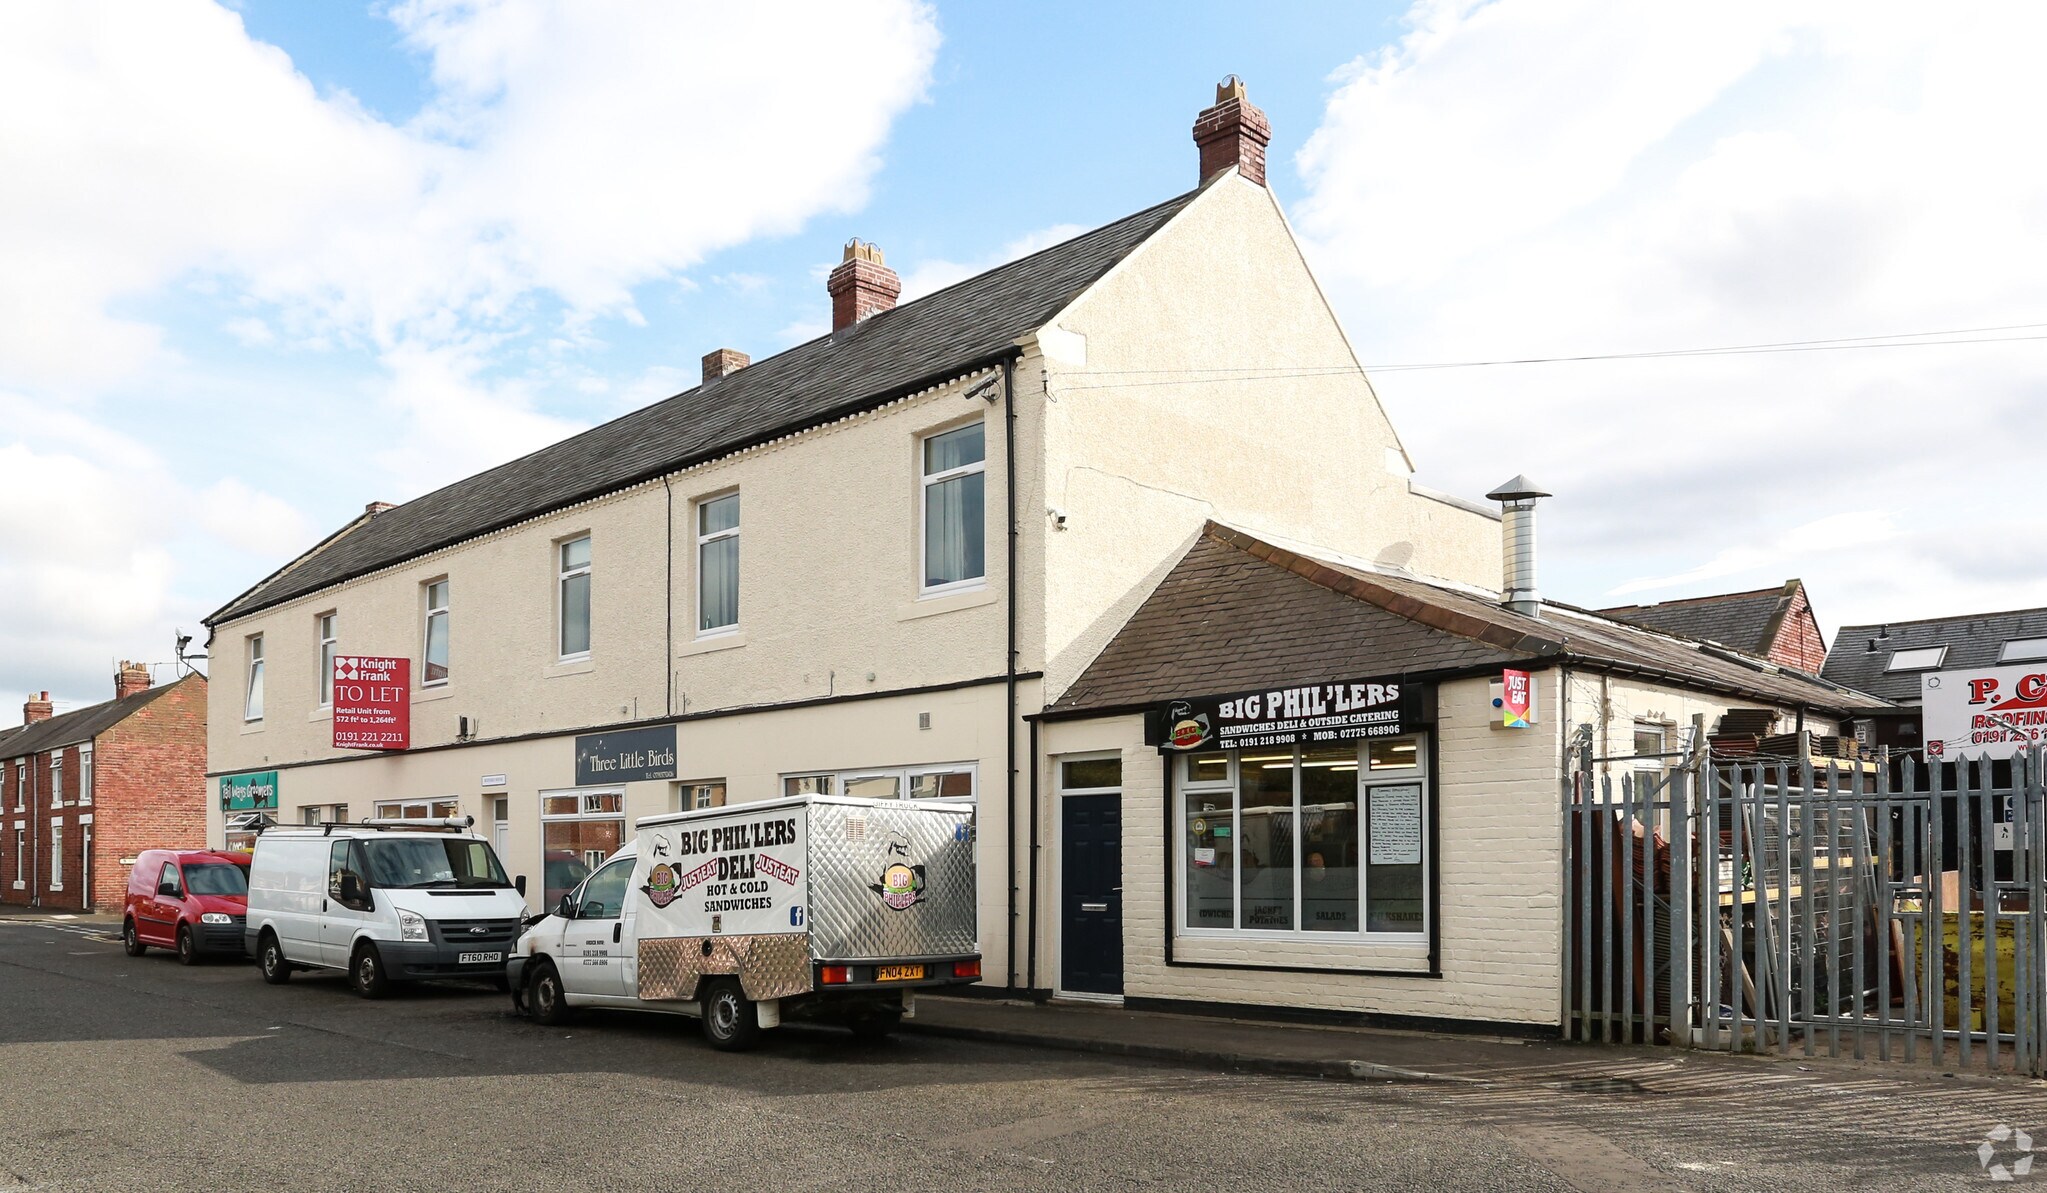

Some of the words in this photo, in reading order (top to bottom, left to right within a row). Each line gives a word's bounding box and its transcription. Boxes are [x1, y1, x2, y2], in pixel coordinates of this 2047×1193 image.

[361, 658, 396, 671] Knight
[361, 671, 390, 681] Frank
[1508, 676, 1526, 691] JUST
[336, 685, 363, 701] TO
[370, 686, 403, 702] LET
[1512, 691, 1526, 705] EAT
[1968, 678, 2001, 705] P.
[1219, 695, 1260, 719] BIG
[1267, 684, 1399, 719] PHIL'LERS
[1220, 722, 1275, 735] SANDWICHES
[1277, 719, 1298, 730] DELI
[1300, 719, 1307, 728] &
[1308, 715, 1348, 727] OUTSIDE
[1350, 710, 1399, 723] CATERING
[1971, 710, 2047, 729] ROOFIN
[335, 731, 359, 741] 0191
[361, 732, 378, 742] 221
[380, 732, 404, 742] 2211
[1220, 740, 1238, 749] TEL:
[1239, 737, 1258, 747] 0191
[1260, 735, 1275, 746] 218
[1276, 734, 1296, 744] 9908
[1313, 730, 1338, 741] MOB:
[1340, 728, 1366, 738] 07775
[1368, 725, 1400, 736] 668906
[1972, 731, 2007, 744] 0191
[590, 754, 617, 772] Three
[620, 750, 645, 770] Little
[648, 747, 674, 767] Birds
[681, 829, 708, 855] BIG
[712, 818, 796, 852] PHIL'LERS
[718, 854, 756, 881] DELI
[755, 854, 781, 879] JUST
[656, 872, 668, 885] BIG
[681, 870, 701, 892] JUST
[893, 874, 908, 887] BIG
[707, 884, 727, 896] HOT
[730, 883, 738, 894] &
[740, 881, 768, 894] COLD
[704, 897, 772, 912] SANDWICHES
[1316, 911, 1346, 921] SALADS
[462, 953, 482, 962] FT60
[483, 952, 499, 961] RHO
[880, 966, 902, 978] FN04
[904, 965, 920, 977] ZXT
